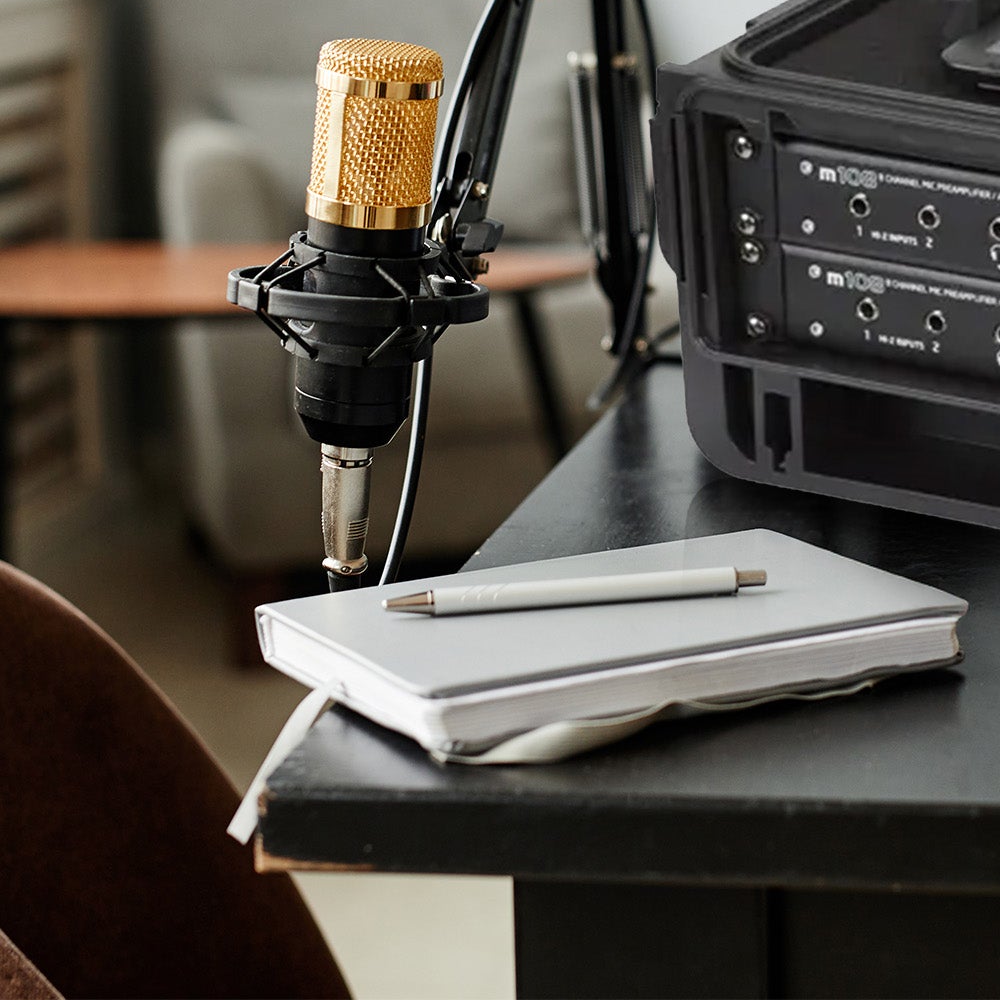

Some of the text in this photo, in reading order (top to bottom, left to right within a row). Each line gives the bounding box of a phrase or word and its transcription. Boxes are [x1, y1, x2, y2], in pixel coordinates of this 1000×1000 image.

[856, 225, 863, 237] 1
[925, 236, 933, 249] 2
[864, 329, 871, 341] 1
[932, 341, 940, 353] 2
